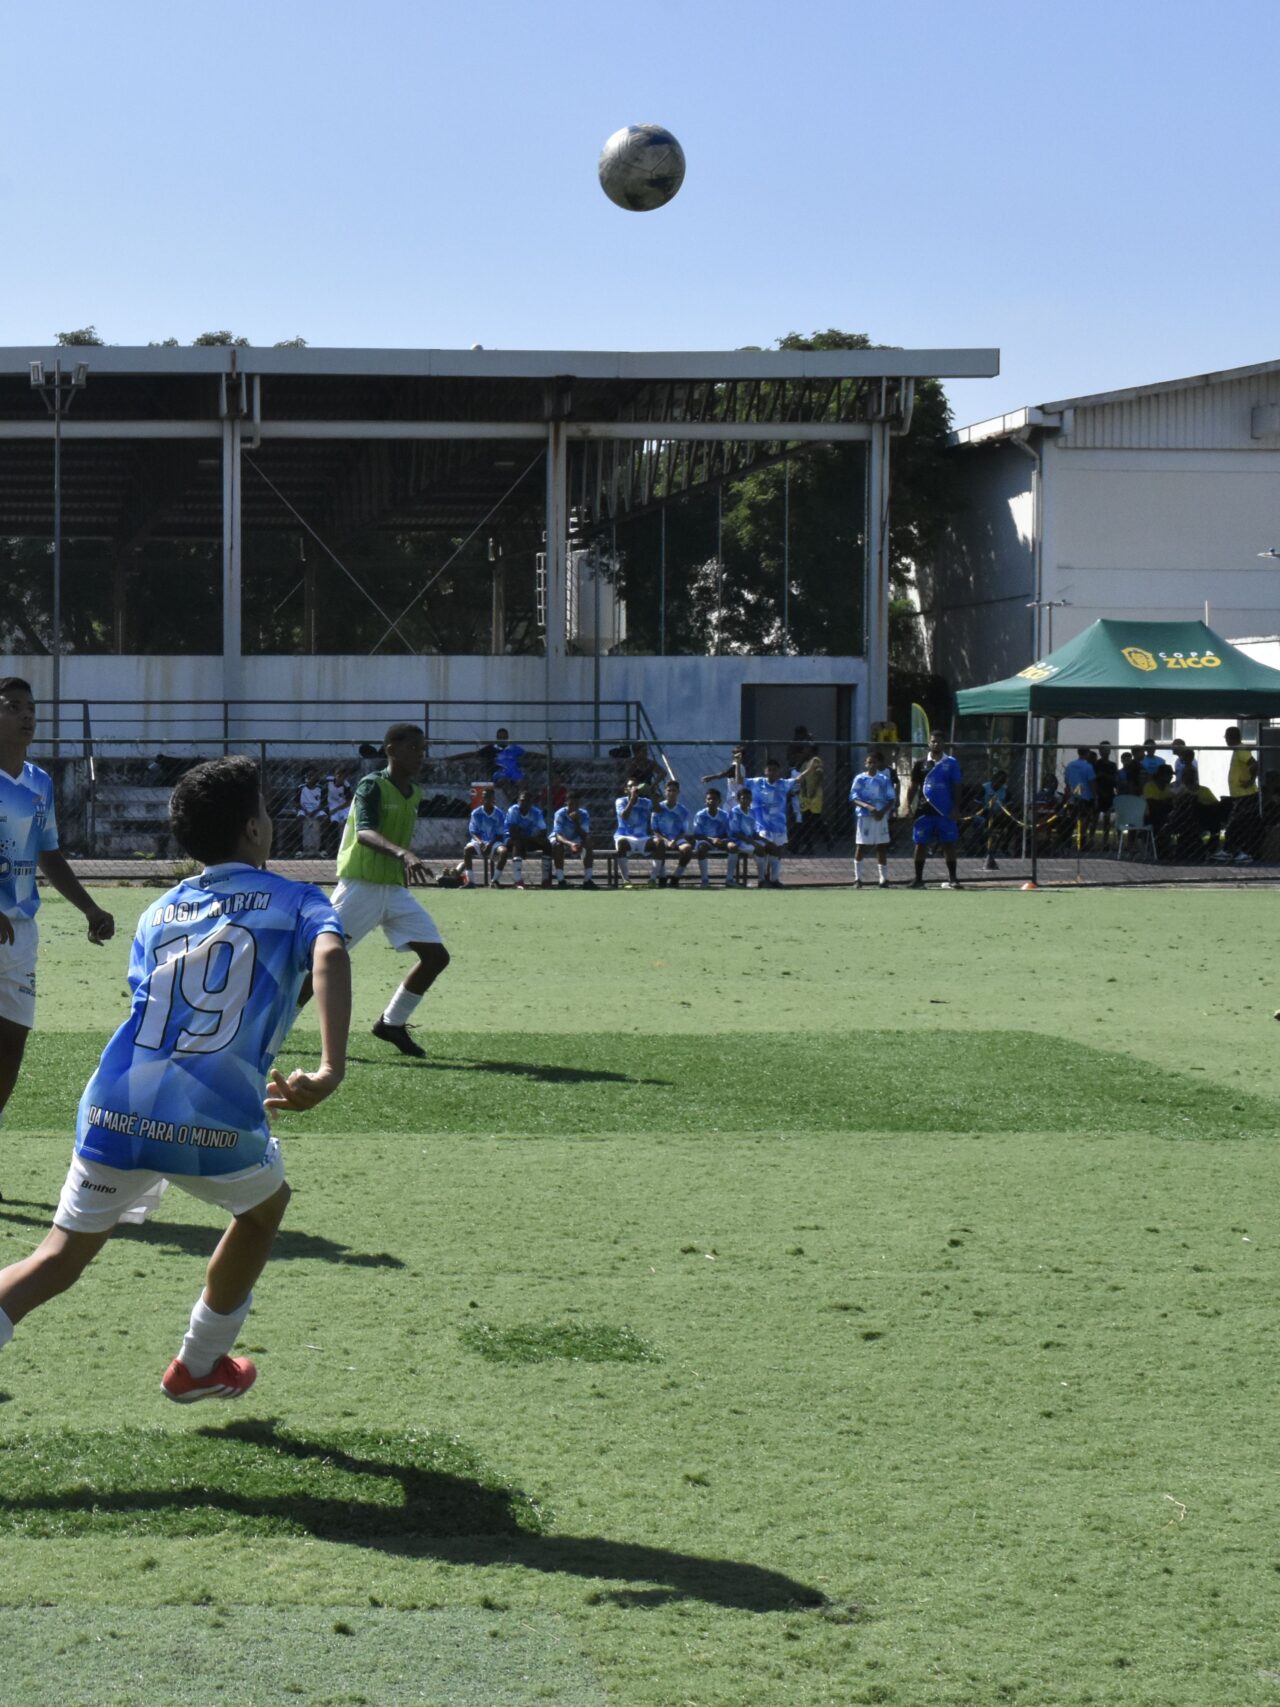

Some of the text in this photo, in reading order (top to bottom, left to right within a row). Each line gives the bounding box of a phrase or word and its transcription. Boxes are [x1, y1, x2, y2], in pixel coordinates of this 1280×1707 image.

[1158, 650, 1215, 658] COPA
[1163, 656, 1222, 669] ZICO
[207, 891, 272, 918] MIRIM
[133, 923, 256, 1054] 19
[88, 1104, 102, 1126] DA
[138, 1117, 174, 1142] PARA
[177, 1125, 189, 1144] O
[190, 1127, 239, 1148] MUNDO
